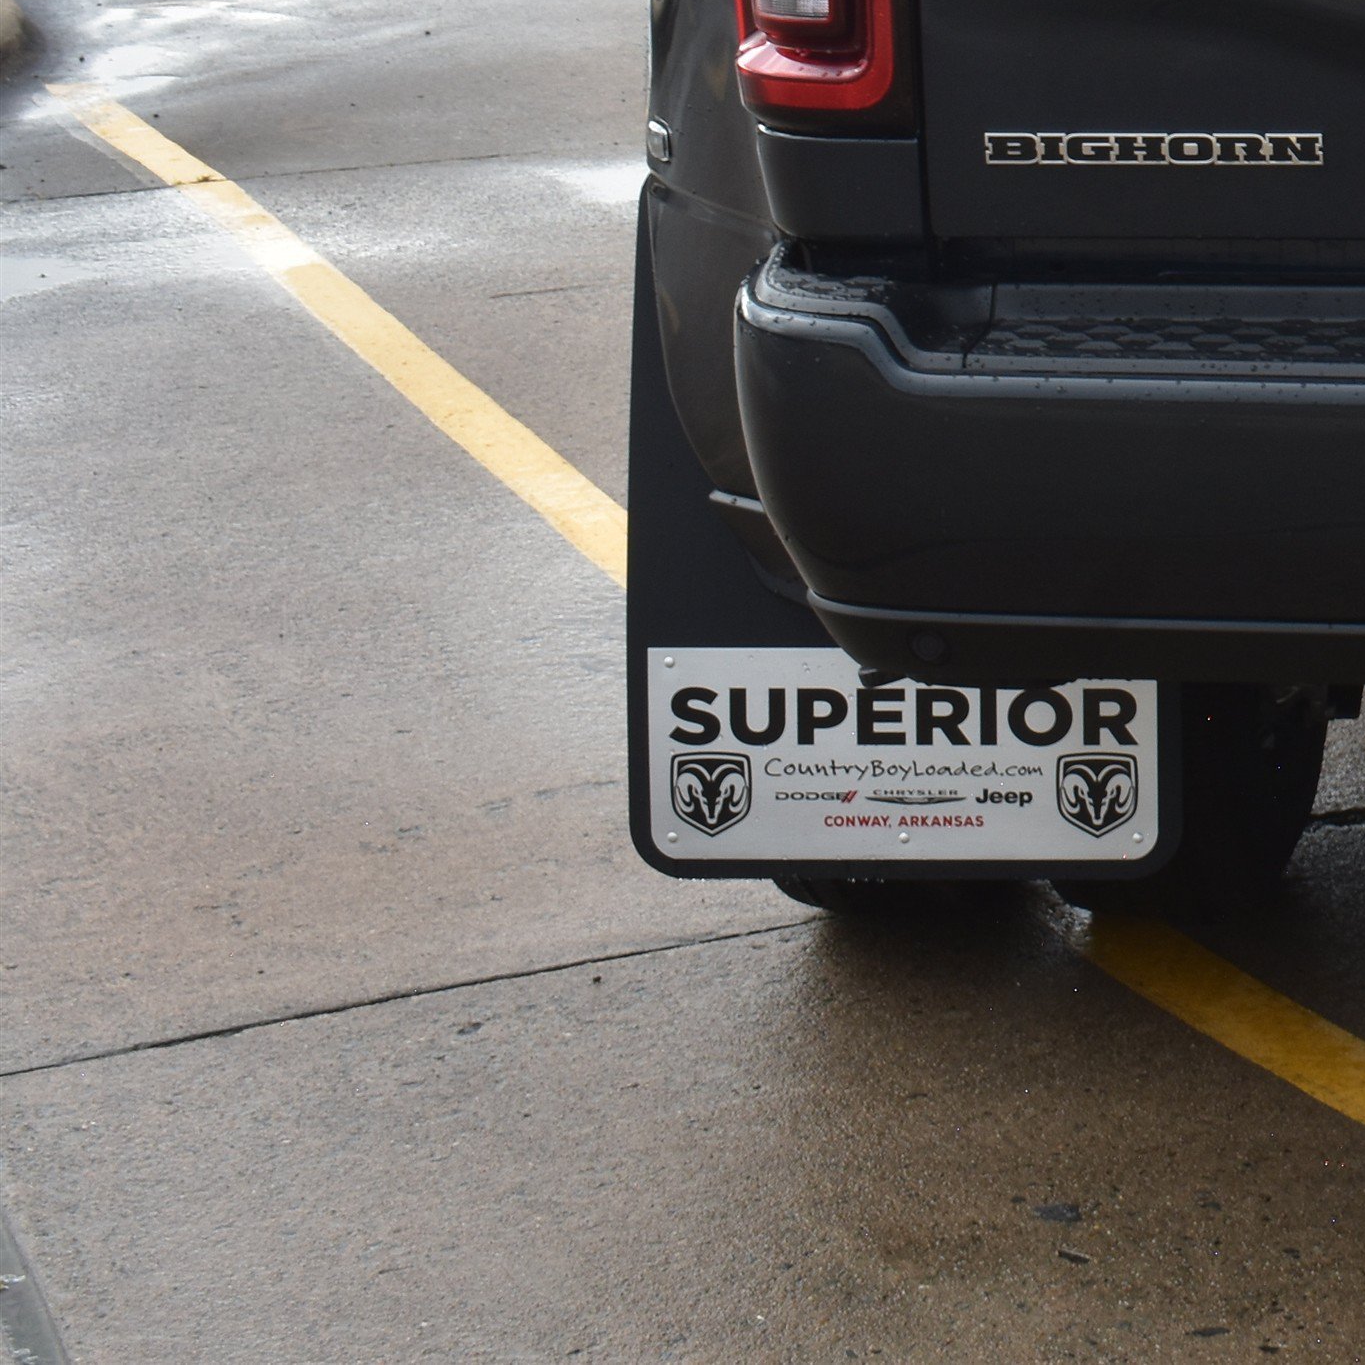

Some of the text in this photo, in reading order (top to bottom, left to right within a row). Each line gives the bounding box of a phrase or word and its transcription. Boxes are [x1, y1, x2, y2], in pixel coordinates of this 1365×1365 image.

[984, 132, 1324, 165] BIGHORN
[668, 686, 1139, 747] SUPERIOR
[764, 757, 1043, 781] CountryBoyLoaded.com
[775, 791, 848, 801] DODGE
[975, 789, 1033, 807] Jeep
[824, 815, 985, 828] CONWAY, ARKANSAS
